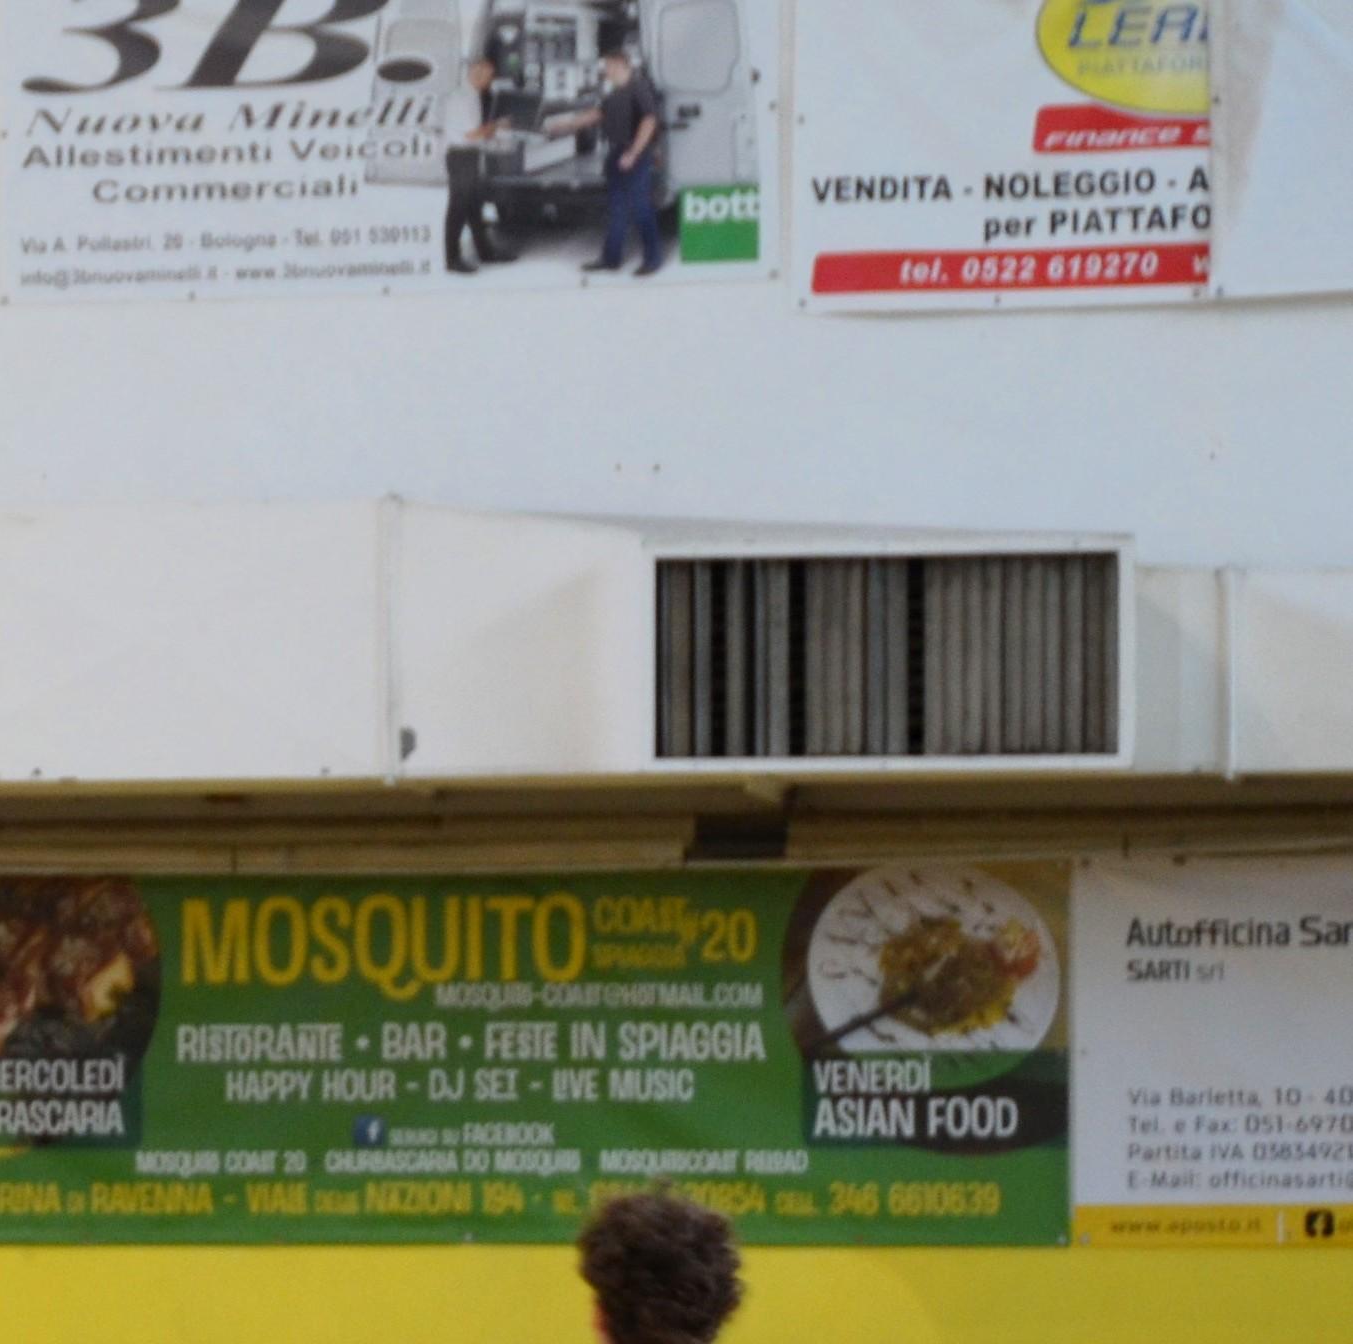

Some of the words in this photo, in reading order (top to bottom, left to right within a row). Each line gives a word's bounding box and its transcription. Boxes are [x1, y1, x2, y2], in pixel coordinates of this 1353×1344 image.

[25, 106, 205, 138] Nuova
[229, 96, 433, 133] Minelli
[22, 142, 273, 169] Allestimenti
[289, 135, 434, 161] Veicoli
[1044, 124, 1183, 149] Finance
[92, 177, 359, 204] Commerciali
[812, 174, 952, 202] VENDITA
[984, 168, 1156, 200] NOLEGGIO
[20, 234, 48, 255] Via
[200, 228, 277, 253] Bologna
[330, 226, 361, 246] 051
[984, 212, 1034, 243] per
[899, 258, 946, 286] tel.
[962, 255, 1036, 284] 0522
[1047, 252, 1158, 280] 619270
[181, 891, 587, 1001] MOSQUITO
[1126, 916, 1290, 948] Autofficina
[1126, 958, 1190, 983] SARTI
[1197, 960, 1225, 982] srl
[176, 1021, 343, 1063] RISTORANTE
[380, 1021, 447, 1060] BAR
[483, 1020, 558, 1061] FESTE
[570, 1020, 606, 1061] IN
[618, 1019, 766, 1062] SPIAGGIA
[225, 1068, 313, 1102] HAPPY
[321, 1067, 396, 1101] HOUR
[428, 1067, 464, 1100] DJ
[473, 1067, 519, 1101] SET
[552, 1067, 599, 1101] LIVE
[608, 1067, 695, 1102] MUSIC
[812, 1055, 932, 1094] VENERDÌ
[1127, 1087, 1160, 1107] Via
[1275, 1087, 1301, 1107] 10
[812, 1097, 916, 1138] ASIAN
[927, 1096, 1020, 1139] FOOD
[1174, 1119, 1186, 1135] e
[1127, 1141, 1203, 1162] Partita
[1209, 1141, 1245, 1161] IVA
[90, 1181, 214, 1216] RAVENNA
